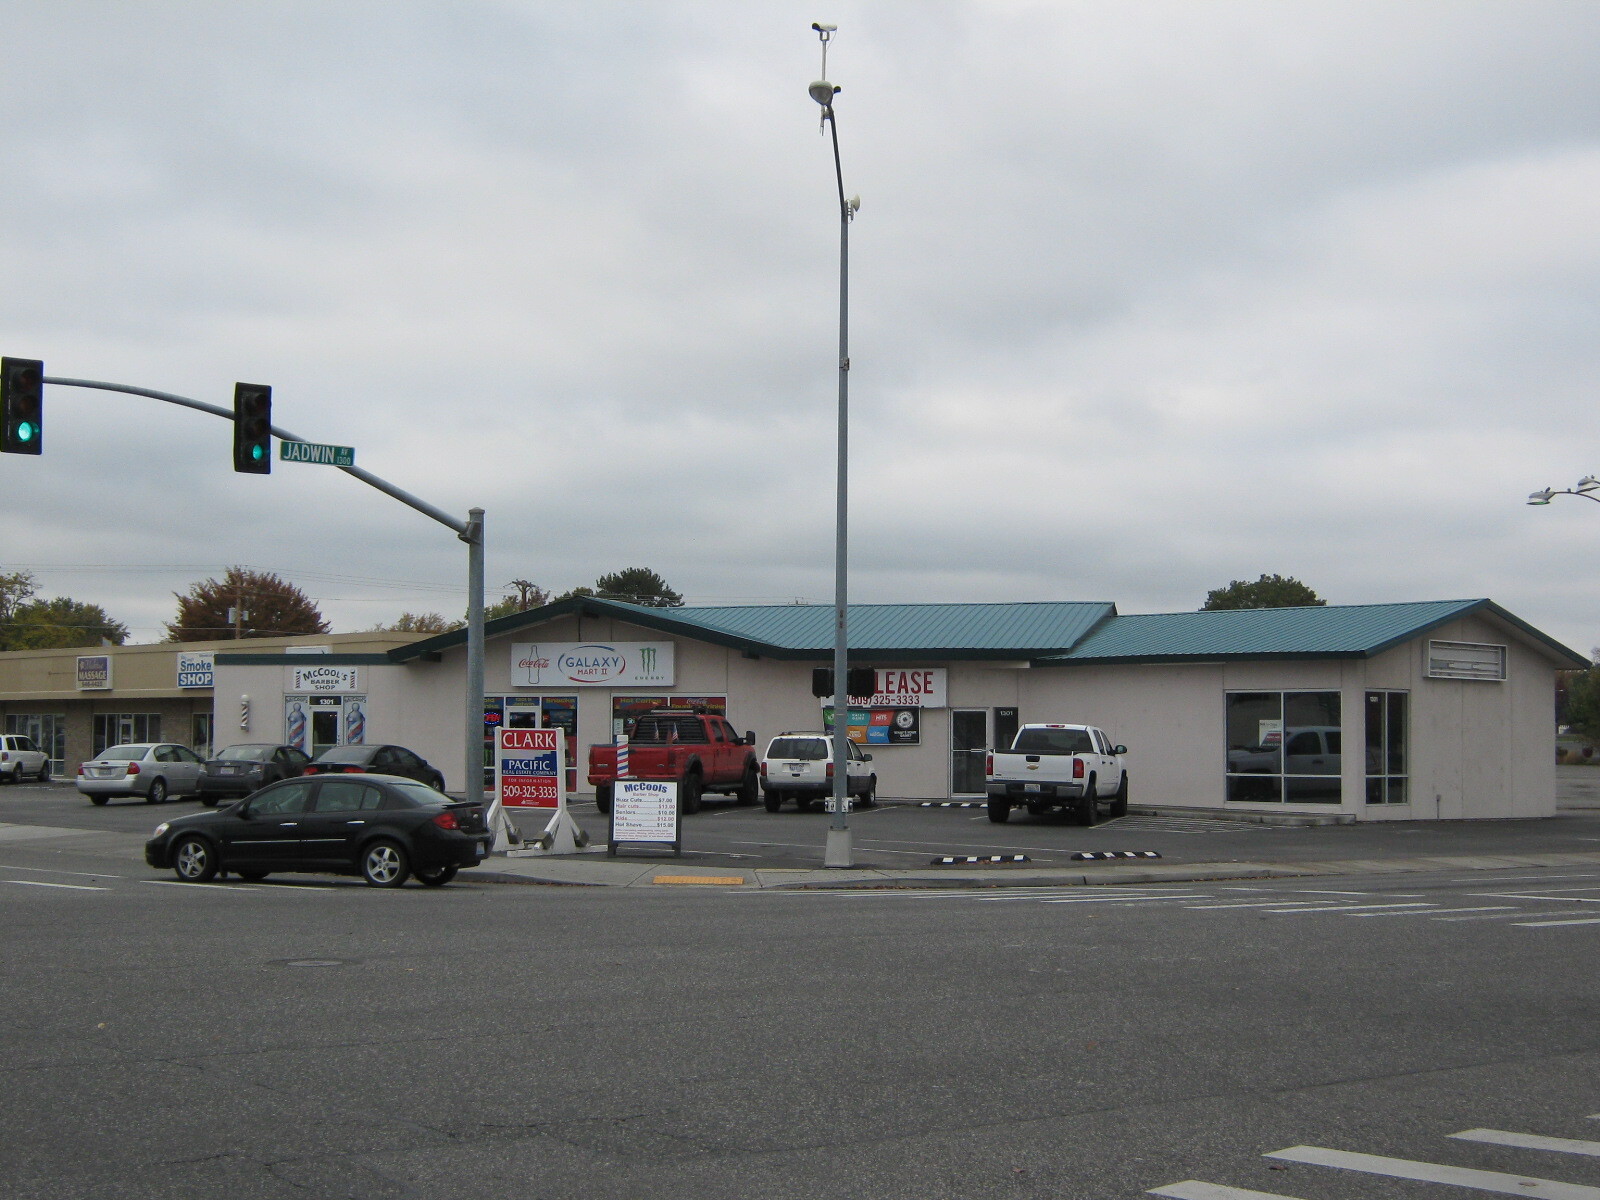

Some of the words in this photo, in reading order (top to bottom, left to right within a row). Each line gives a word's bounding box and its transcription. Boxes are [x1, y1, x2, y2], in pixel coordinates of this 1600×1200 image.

[283, 443, 335, 463] JADWIN
[337, 456, 351, 465] 1300
[180, 660, 212, 671] Smoke
[565, 657, 620, 667] GALAXY
[79, 671, 107, 680] MASSAGE
[180, 673, 212, 685] SHOP
[874, 672, 934, 694] LEASE
[503, 732, 555, 748] CLARK
[509, 760, 550, 771] PACIFIC
[503, 785, 557, 798] 509-325-3333
[624, 783, 668, 793] McCools
